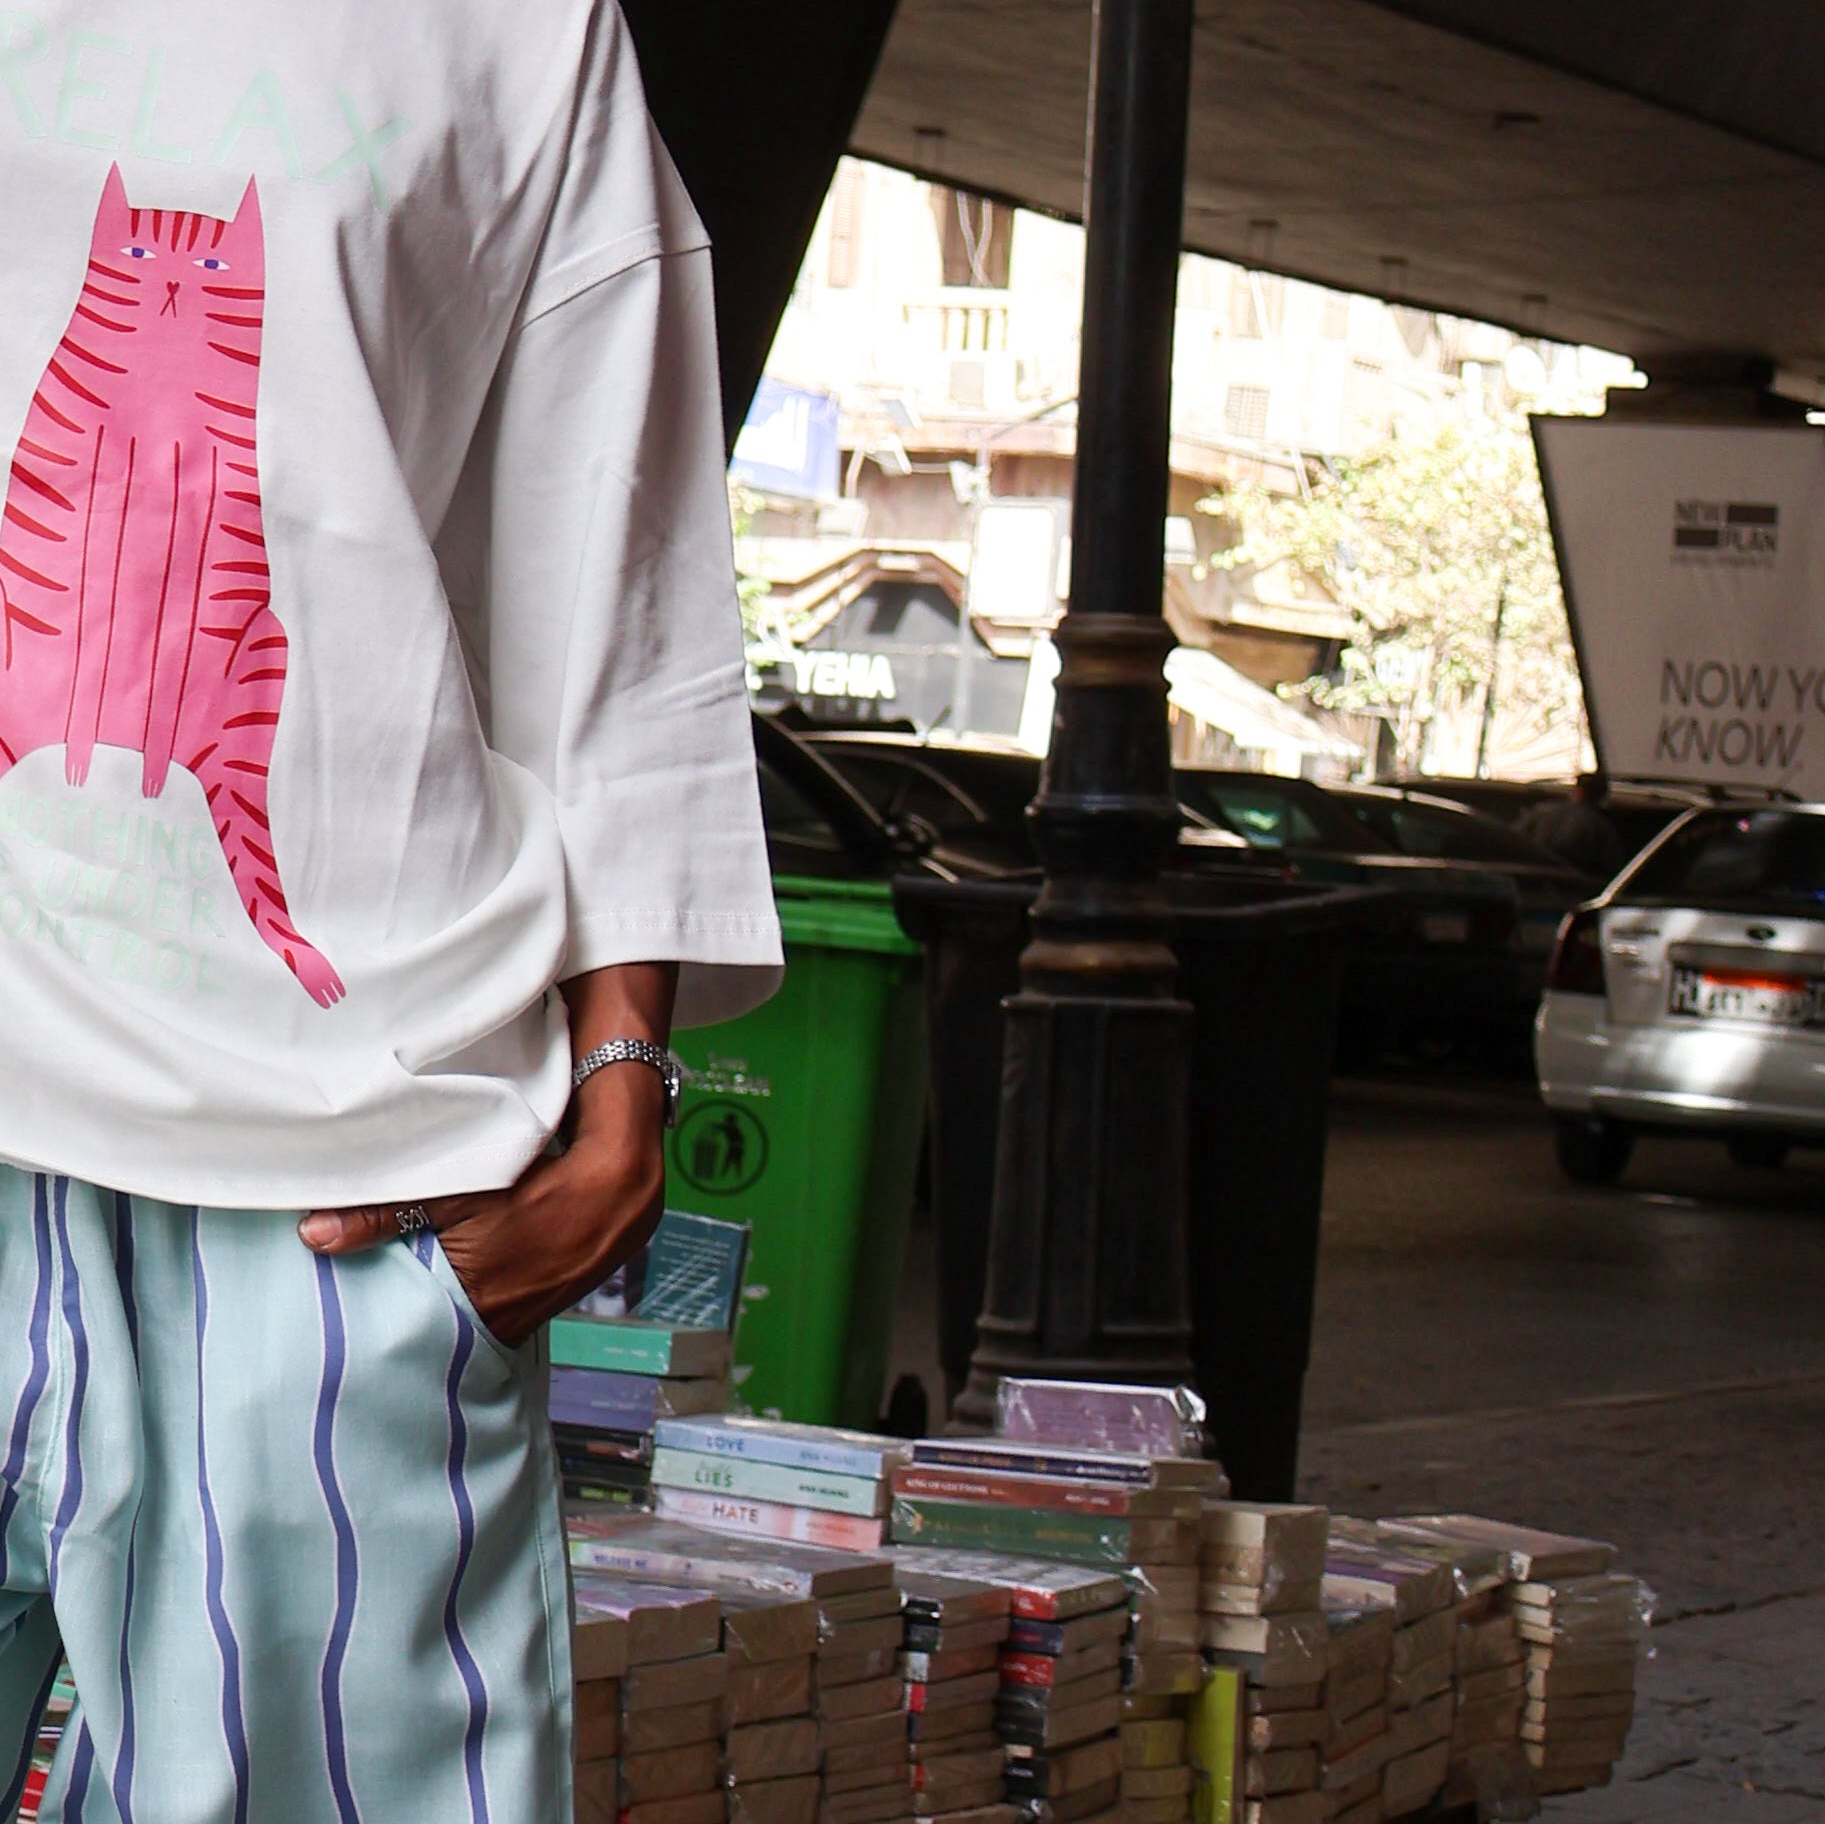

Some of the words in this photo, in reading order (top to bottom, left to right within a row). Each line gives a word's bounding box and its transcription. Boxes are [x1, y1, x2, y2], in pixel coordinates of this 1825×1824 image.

[1659, 659, 1779, 713] NOW
[1655, 712, 1805, 772] KNOW.
[37, 856, 227, 940] UNDER
[704, 1433, 745, 1454] LOVE
[694, 1470, 734, 1490] LIES
[712, 1501, 760, 1525] HATE
